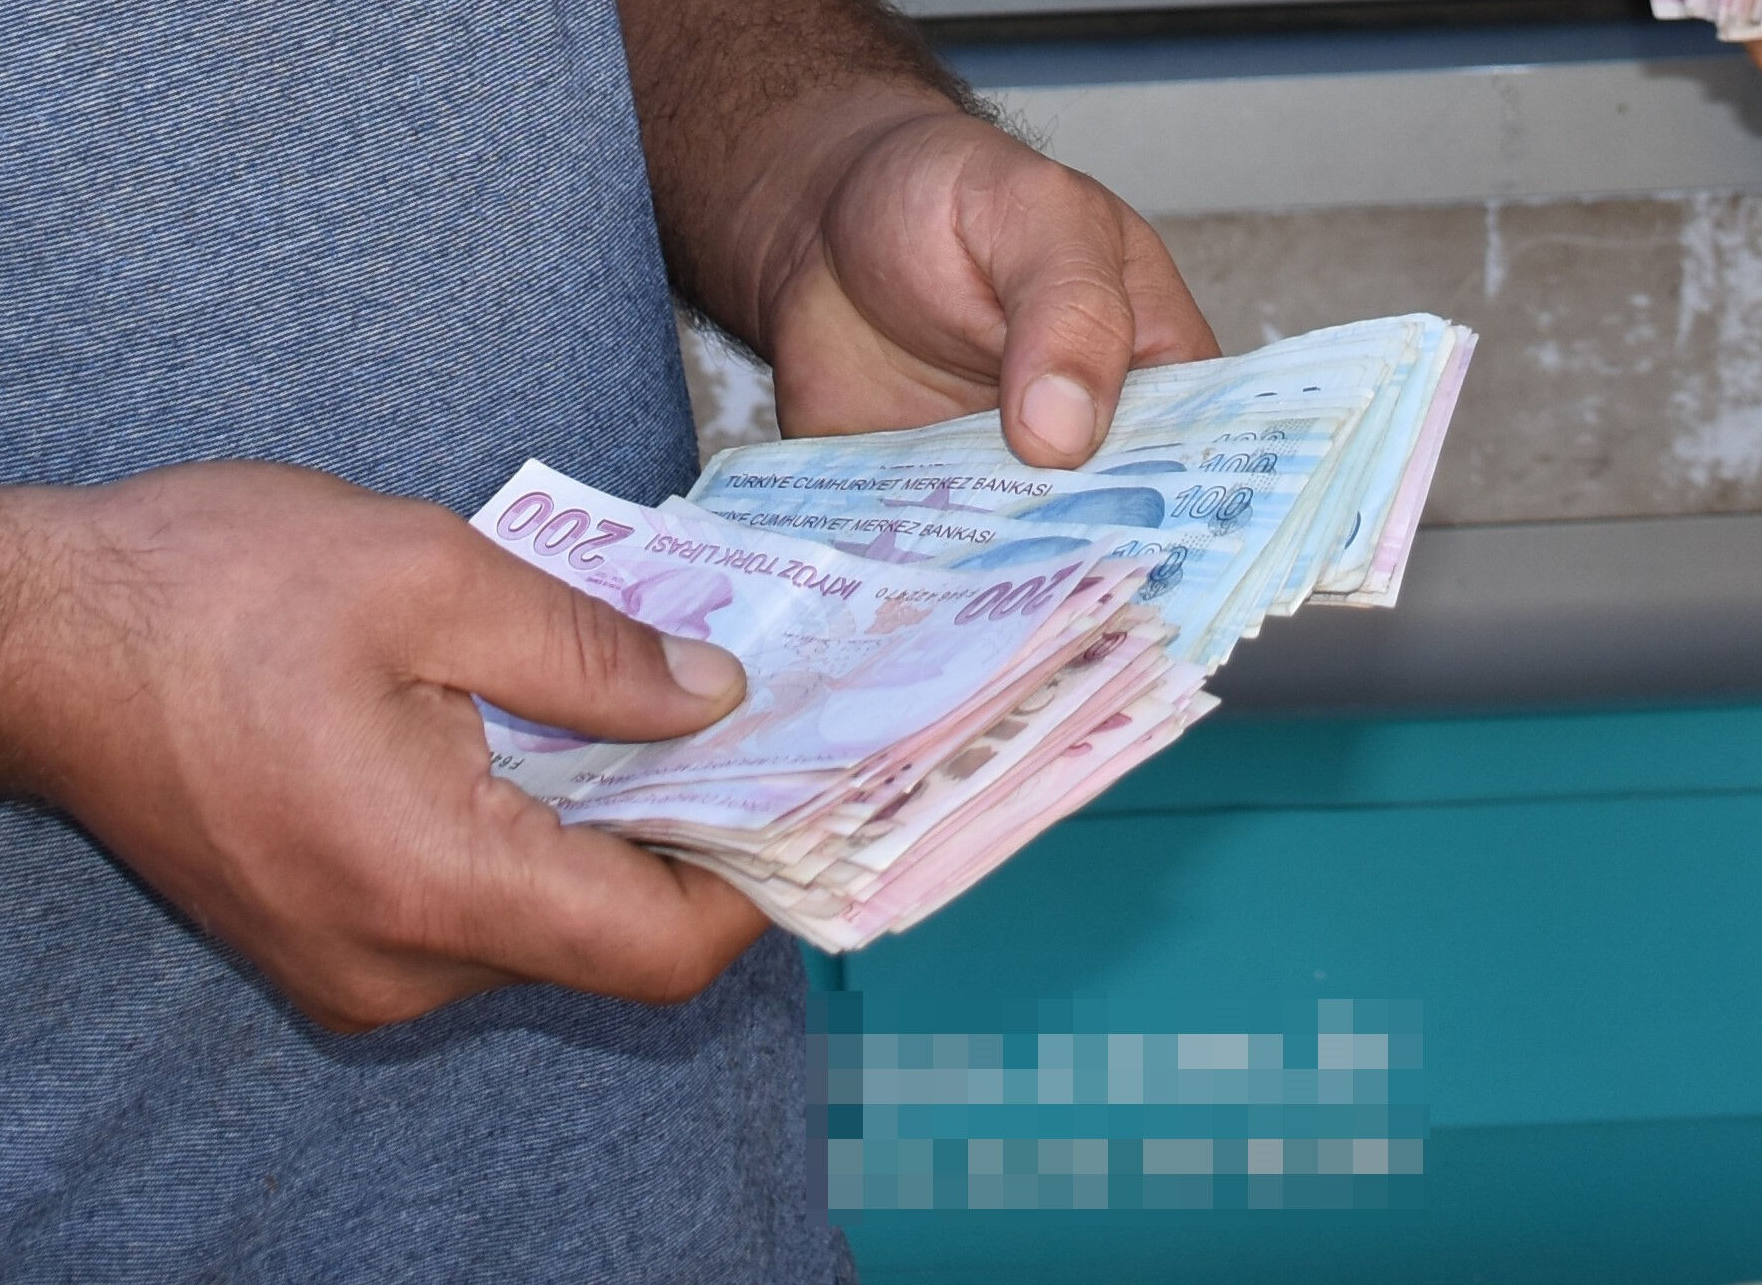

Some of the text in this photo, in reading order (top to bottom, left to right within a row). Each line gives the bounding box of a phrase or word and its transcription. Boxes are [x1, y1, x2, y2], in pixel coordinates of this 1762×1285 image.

[725, 473, 1053, 497] TÜRKİYE CUMHURİYET MERKEZ BANKASI
[1171, 485, 1254, 521] 100
[496, 491, 635, 570] 200
[853, 518, 922, 535] MERKEZ
[919, 523, 996, 544] BANKASI
[715, 547, 779, 575] TÜRK
[953, 561, 1084, 626] 200
